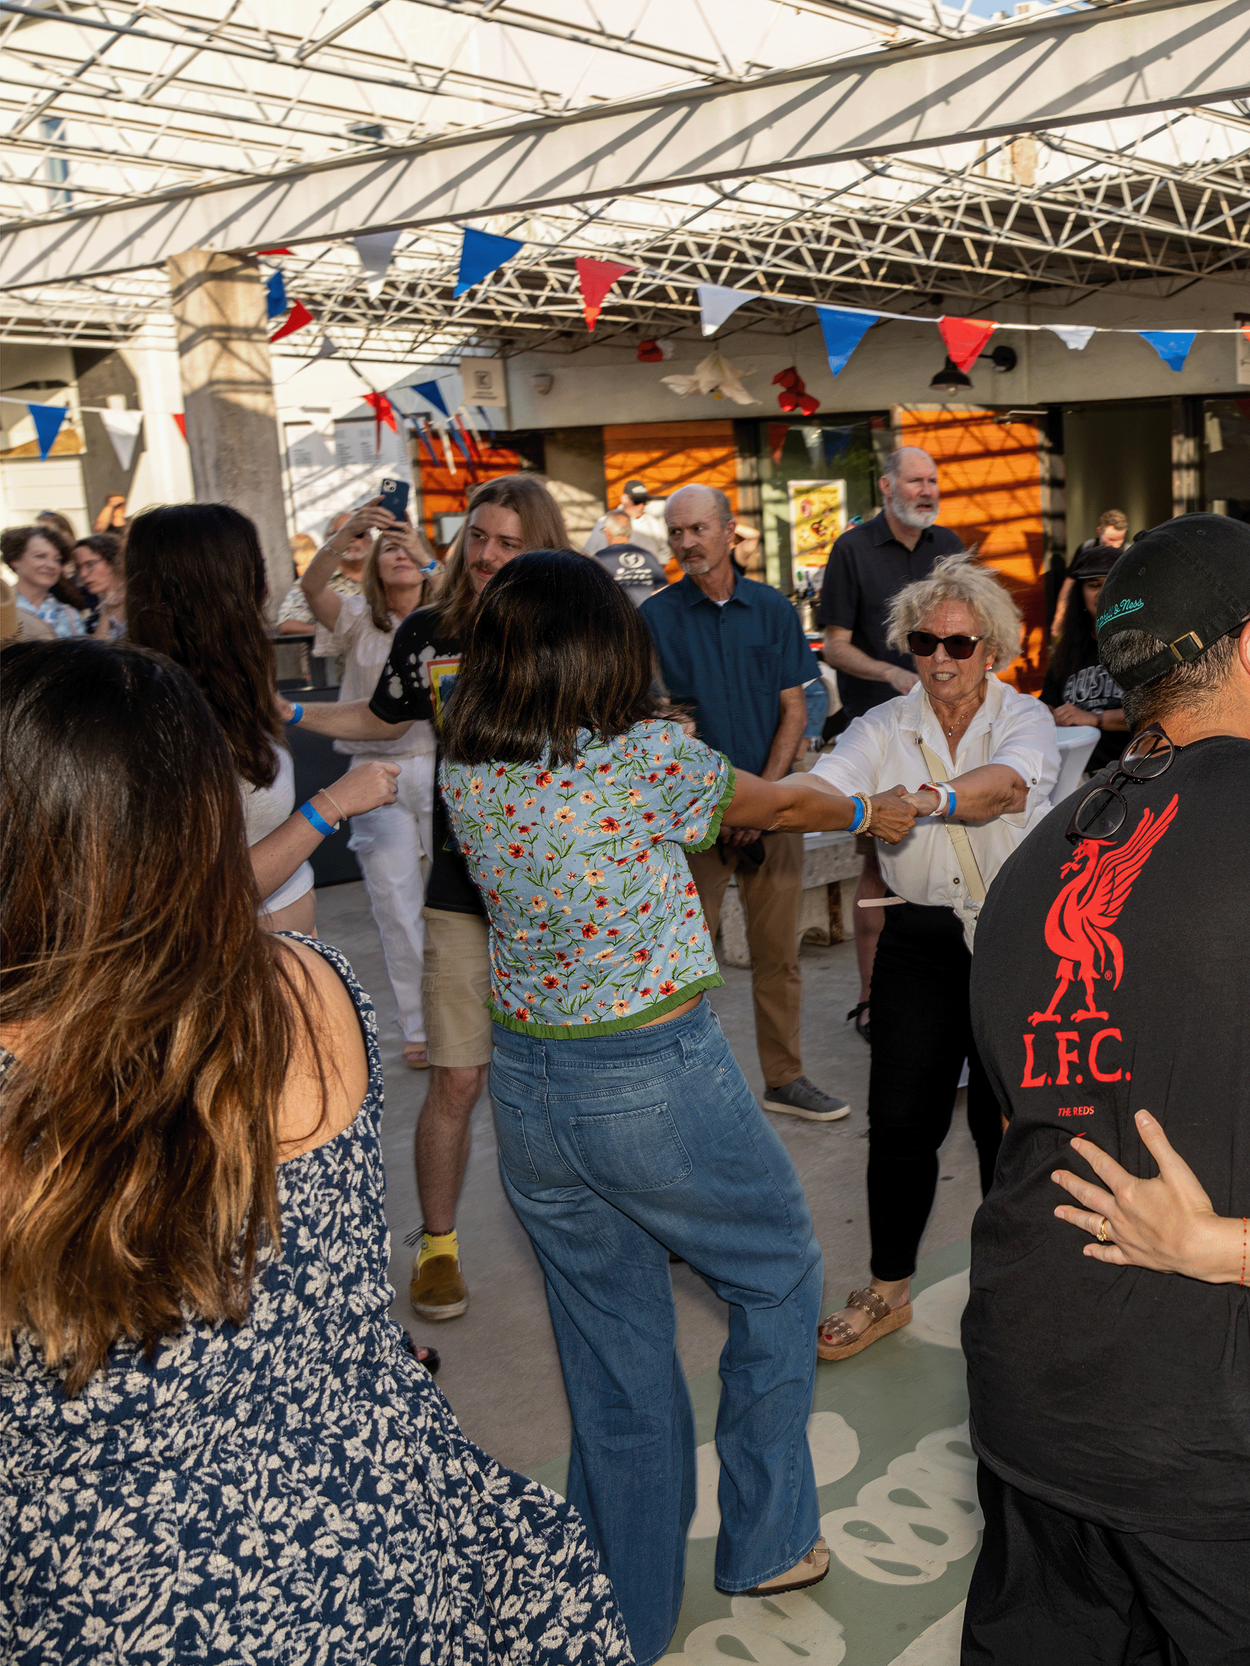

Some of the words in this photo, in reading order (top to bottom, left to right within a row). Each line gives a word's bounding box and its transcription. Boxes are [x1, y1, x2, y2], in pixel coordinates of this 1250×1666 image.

[1120, 598, 1145, 612] Ness
[1020, 1027, 1132, 1088] L.F.C.
[1057, 1107, 1072, 1117] THE
[1072, 1105, 1095, 1116] REDS
